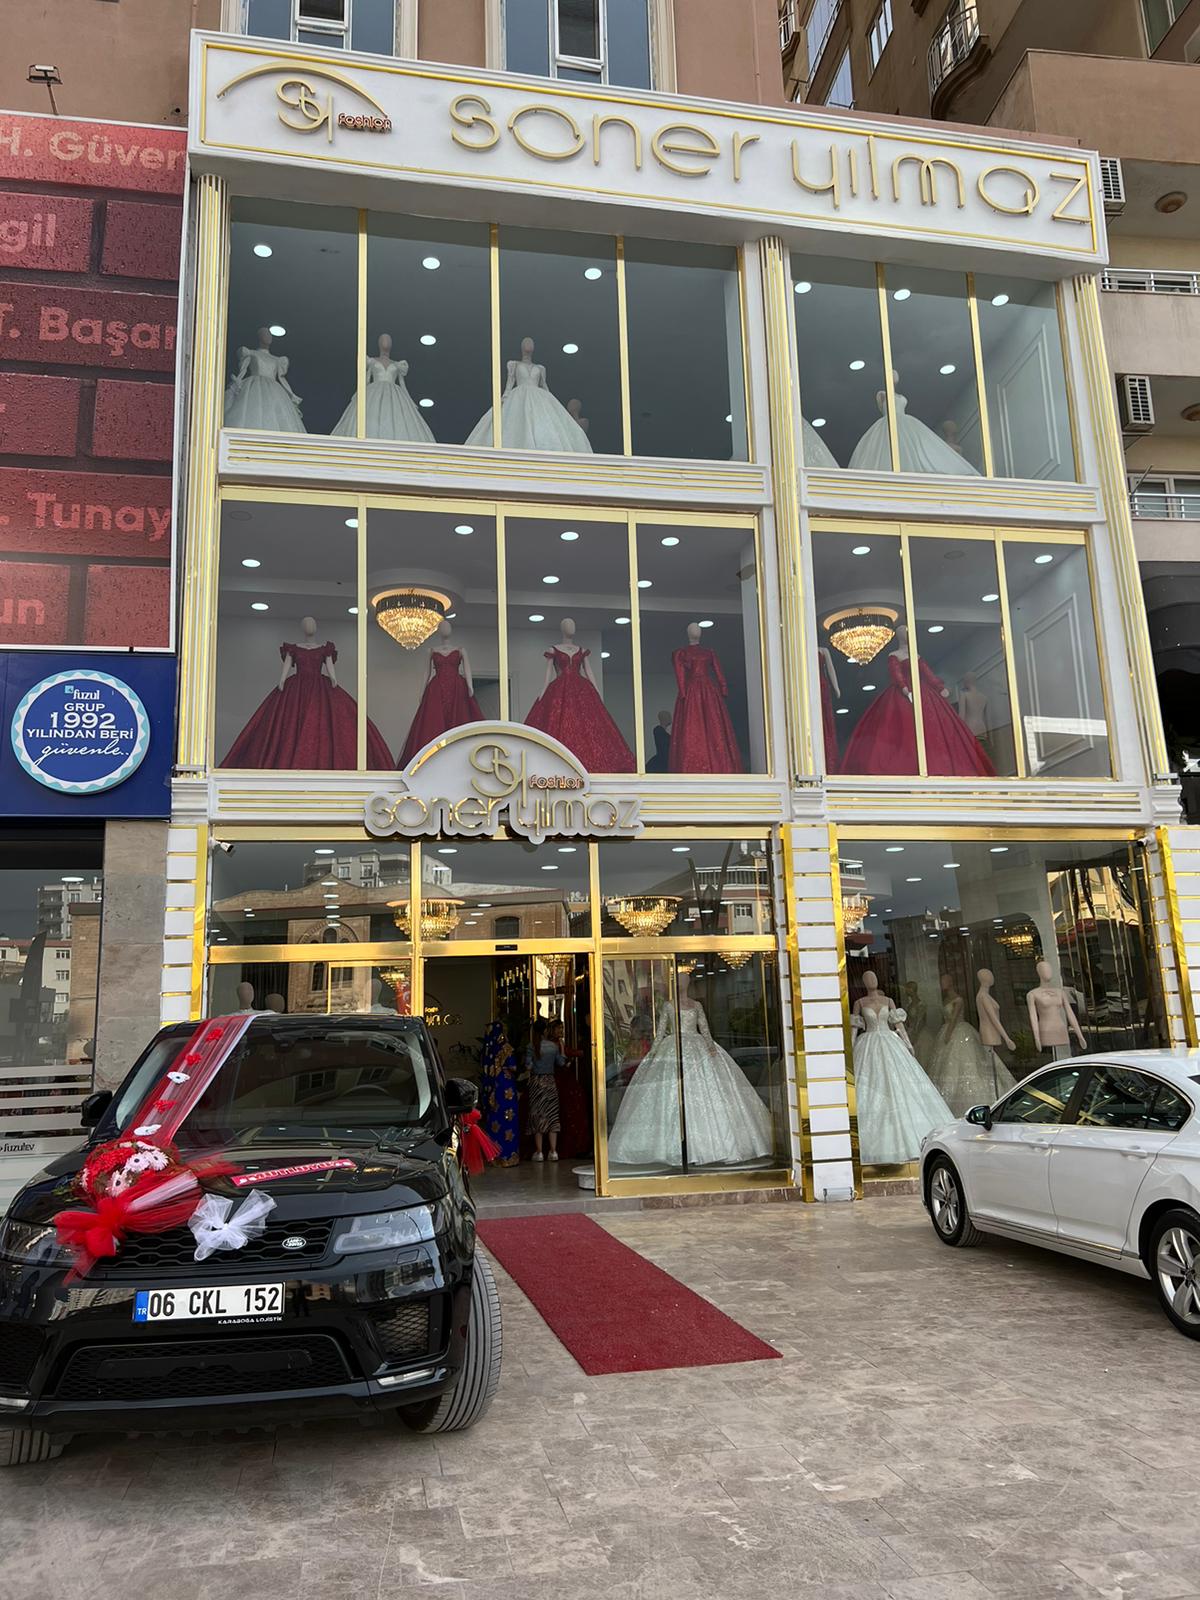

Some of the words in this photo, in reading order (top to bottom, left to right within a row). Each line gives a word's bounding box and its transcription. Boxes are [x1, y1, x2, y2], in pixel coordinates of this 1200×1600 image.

[337, 112, 392, 133] fashion
[450, 94, 760, 182] soner
[27, 492, 171, 541] Tunay
[50, 711, 116, 729] 1992
[64, 703, 105, 712] GRUP
[27, 729, 96, 739] YILINDAN
[100, 728, 134, 739] BERİ
[371, 796, 503, 830] soner
[149, 1293, 175, 1317] 06
[189, 1290, 227, 1315] CKL
[244, 1287, 280, 1312] 152
